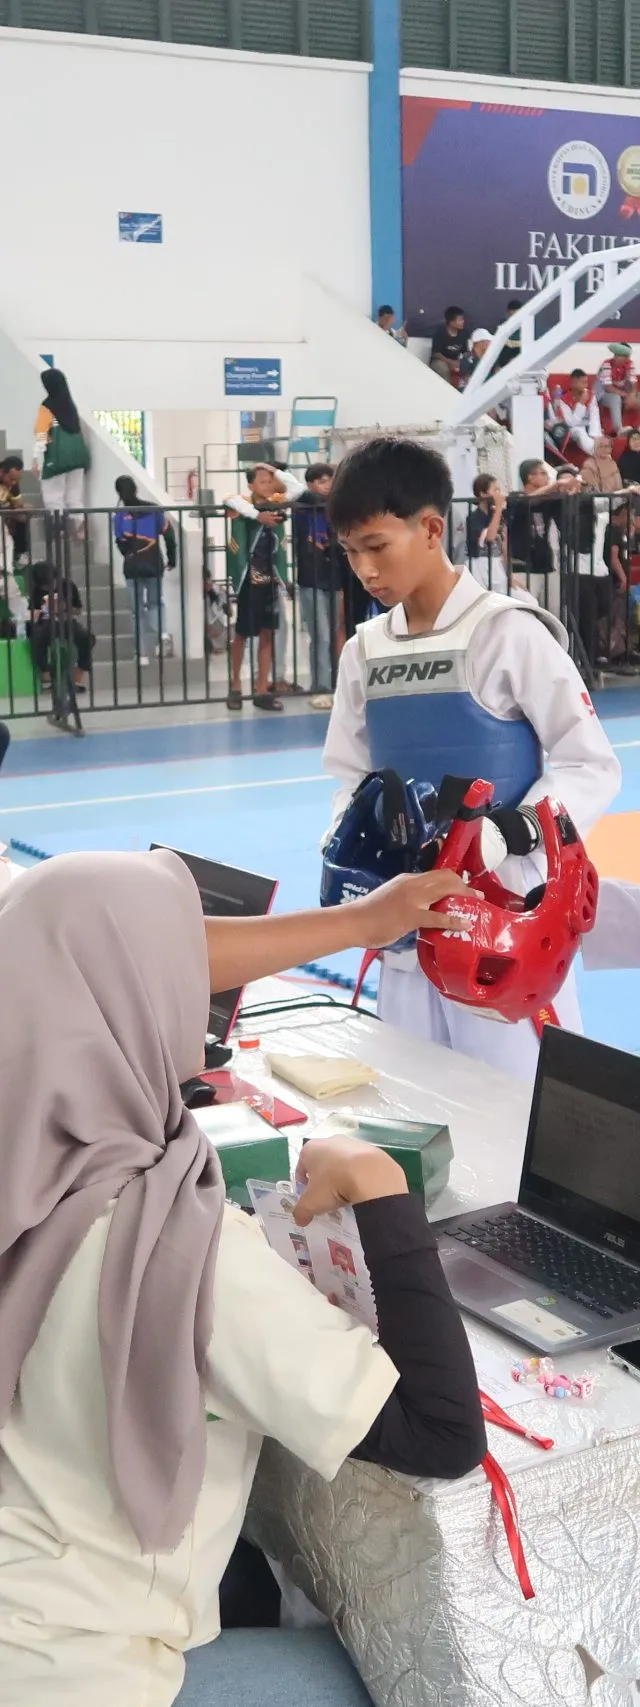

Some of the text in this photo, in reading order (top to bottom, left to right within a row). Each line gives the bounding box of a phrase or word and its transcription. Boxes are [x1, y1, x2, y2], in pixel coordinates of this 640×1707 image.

[368, 659, 453, 686] KPNP
[342, 882, 370, 895] KPNP
[603, 1231, 625, 1248] ASUS
